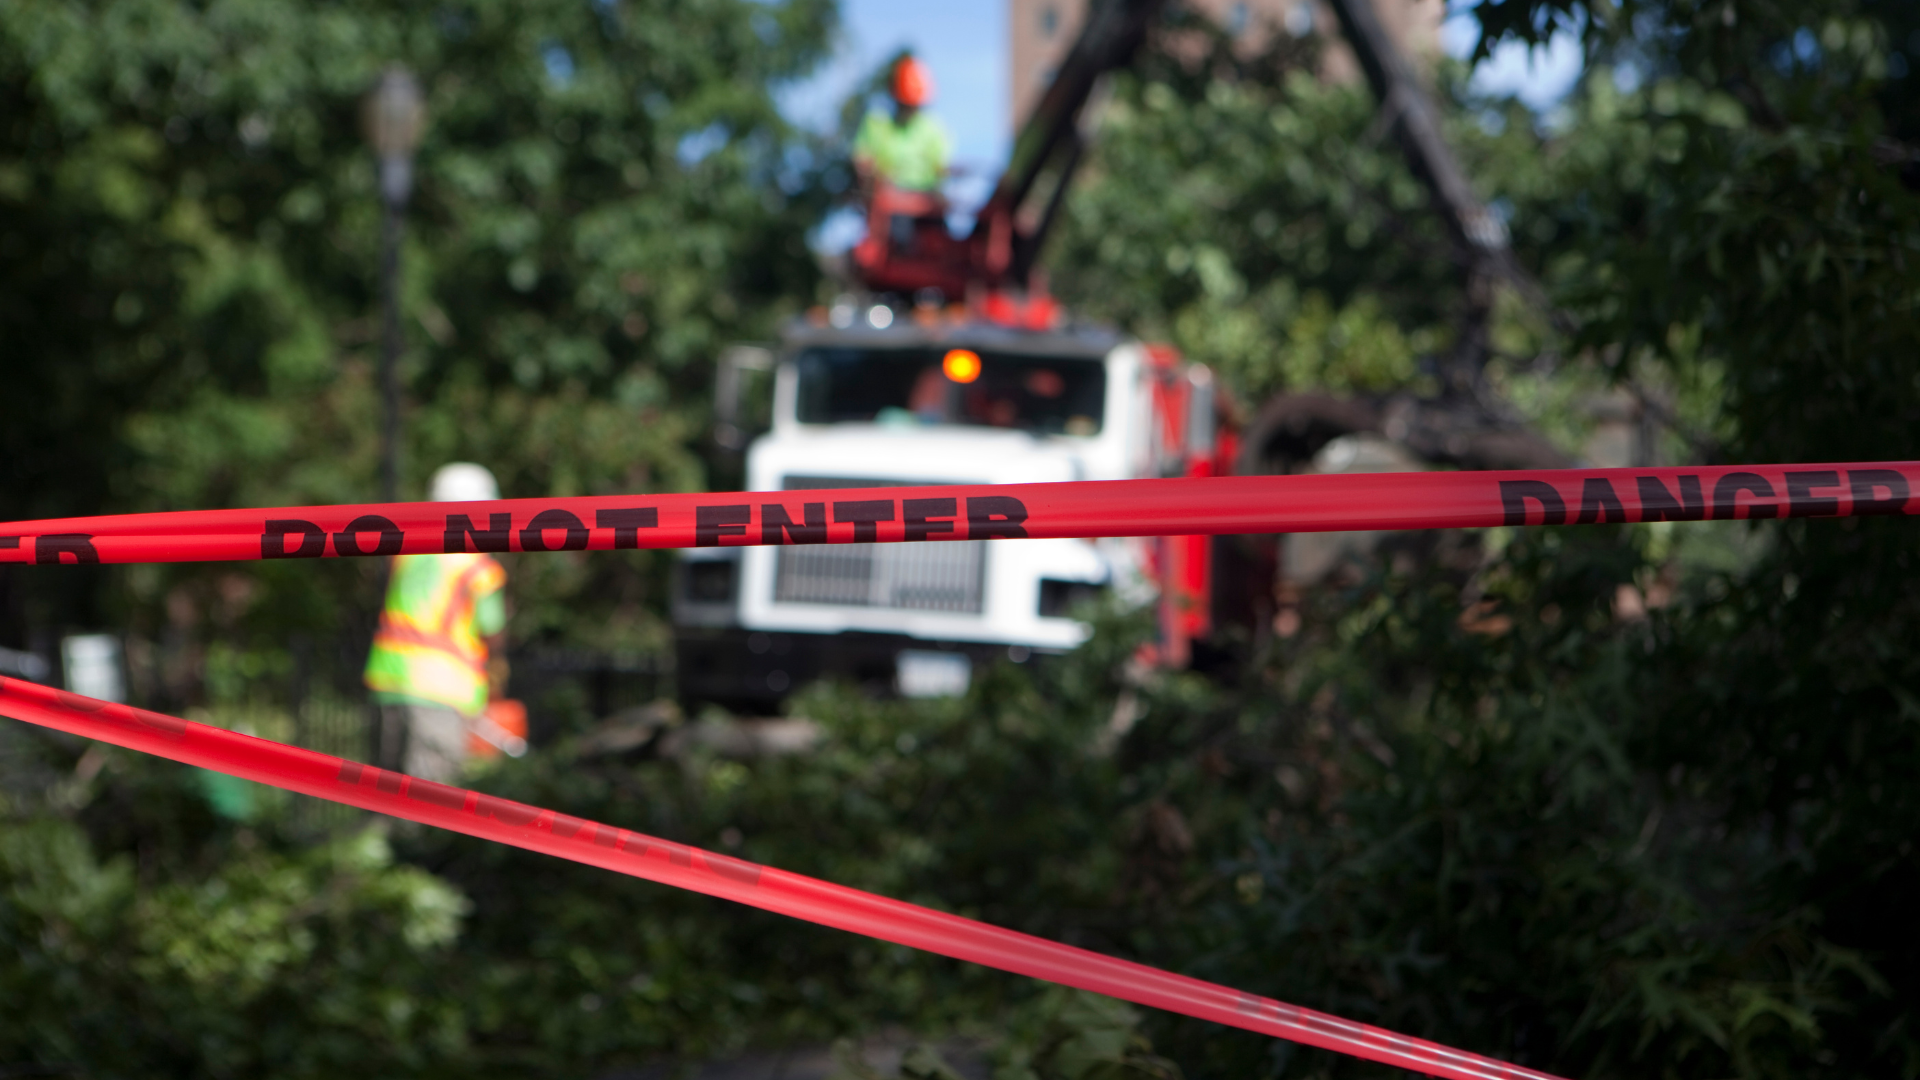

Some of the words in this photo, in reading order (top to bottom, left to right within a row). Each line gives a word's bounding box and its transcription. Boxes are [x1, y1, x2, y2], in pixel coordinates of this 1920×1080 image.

[261, 514, 405, 559] DO
[443, 507, 658, 554] NOT
[696, 495, 1030, 547] ENTER
[1498, 469, 1910, 526] DANGER
